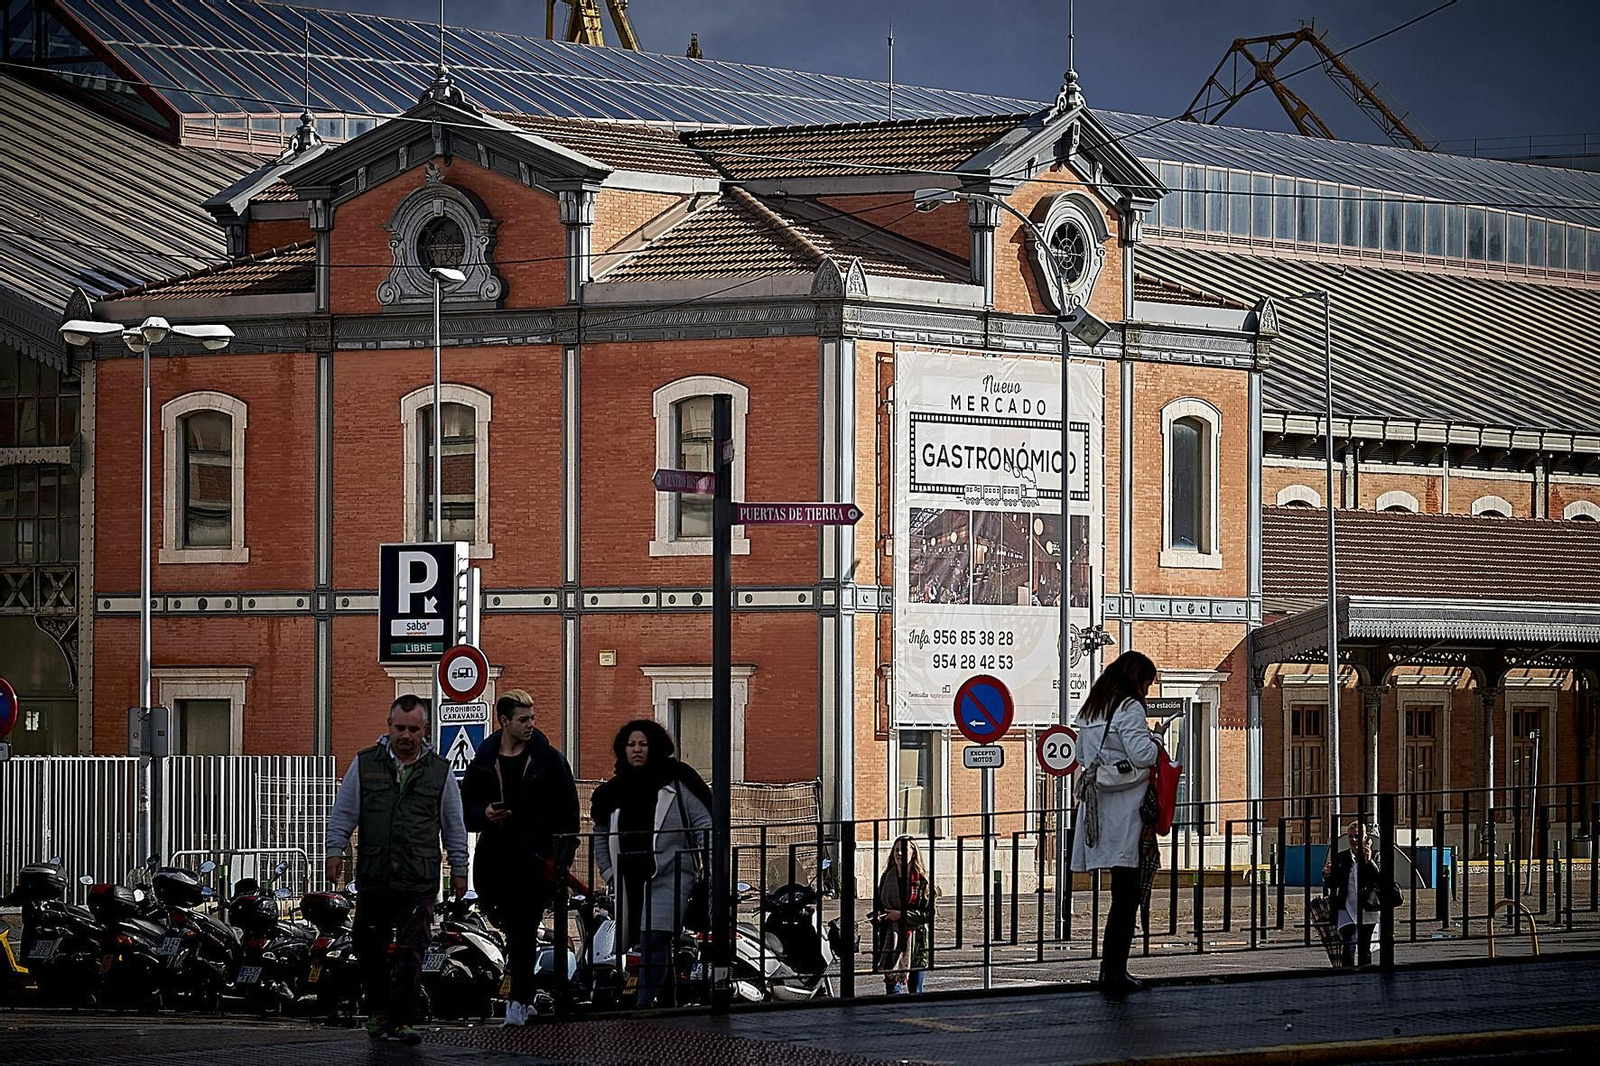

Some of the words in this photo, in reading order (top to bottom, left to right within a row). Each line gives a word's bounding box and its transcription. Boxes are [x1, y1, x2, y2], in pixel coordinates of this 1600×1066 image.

[982, 374, 1022, 394] Nuevo
[950, 394, 1047, 416] MERCADO
[922, 442, 1077, 475] GASTRONÓMICO
[740, 507, 786, 521] PUERTAS
[789, 507, 803, 521] DE
[805, 507, 844, 521] TIERRA
[398, 551, 438, 614] P
[406, 619, 427, 631] saba
[933, 629, 957, 645] 956
[960, 630, 976, 645] 85
[979, 630, 995, 646] 38
[998, 631, 1014, 646] 28
[405, 643, 432, 652] LIBRE
[933, 654, 957, 669] 954
[960, 654, 976, 669] 28
[980, 655, 995, 669] 42
[998, 655, 1014, 670] 53
[1156, 701, 1181, 709] estación
[1046, 742, 1072, 759] 20
